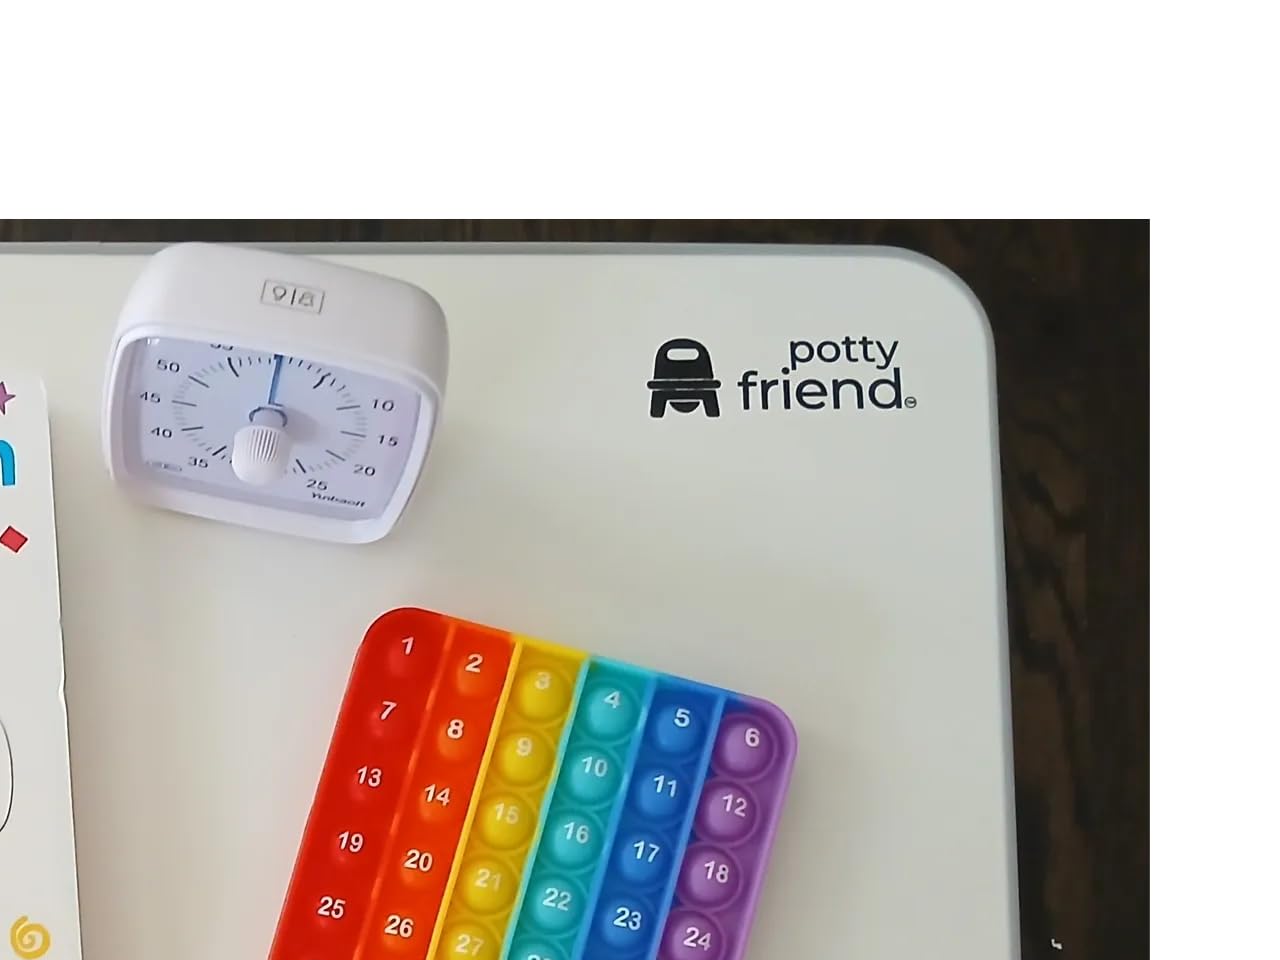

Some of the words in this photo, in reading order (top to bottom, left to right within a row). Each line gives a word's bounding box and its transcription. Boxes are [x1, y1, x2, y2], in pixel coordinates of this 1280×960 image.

[789, 336, 899, 370] potty
[157, 359, 180, 373] 50
[738, 367, 903, 410] friend
[140, 391, 161, 404] 45
[372, 398, 395, 412] 10
[151, 427, 172, 439] 40
[377, 434, 398, 447] 15
[188, 456, 209, 469] 35
[353, 463, 376, 477] 20
[306, 478, 328, 491] 25
[400, 636, 416, 655] 1
[464, 654, 483, 674] 2
[535, 672, 552, 690] 3
[603, 691, 622, 709] 4
[673, 708, 691, 728] 5
[744, 728, 761, 747] 6
[380, 701, 397, 721] 7
[447, 719, 465, 739] 8
[515, 737, 533, 757] 9
[581, 756, 608, 777] 10
[653, 775, 678, 798] 11
[721, 794, 747, 817] 12
[355, 765, 383, 788] 13
[423, 784, 450, 807] 14
[494, 803, 520, 825] 15
[562, 822, 589, 844] 16
[632, 841, 660, 863] 17
[703, 860, 729, 883] 18
[337, 831, 364, 853] 19
[403, 849, 433, 873] 20
[474, 869, 502, 891] 21
[542, 888, 572, 911] 22
[613, 907, 642, 931] 23
[682, 927, 712, 951] 24
[317, 896, 346, 919] 25
[384, 914, 414, 938] 26
[455, 934, 484, 957] 27
